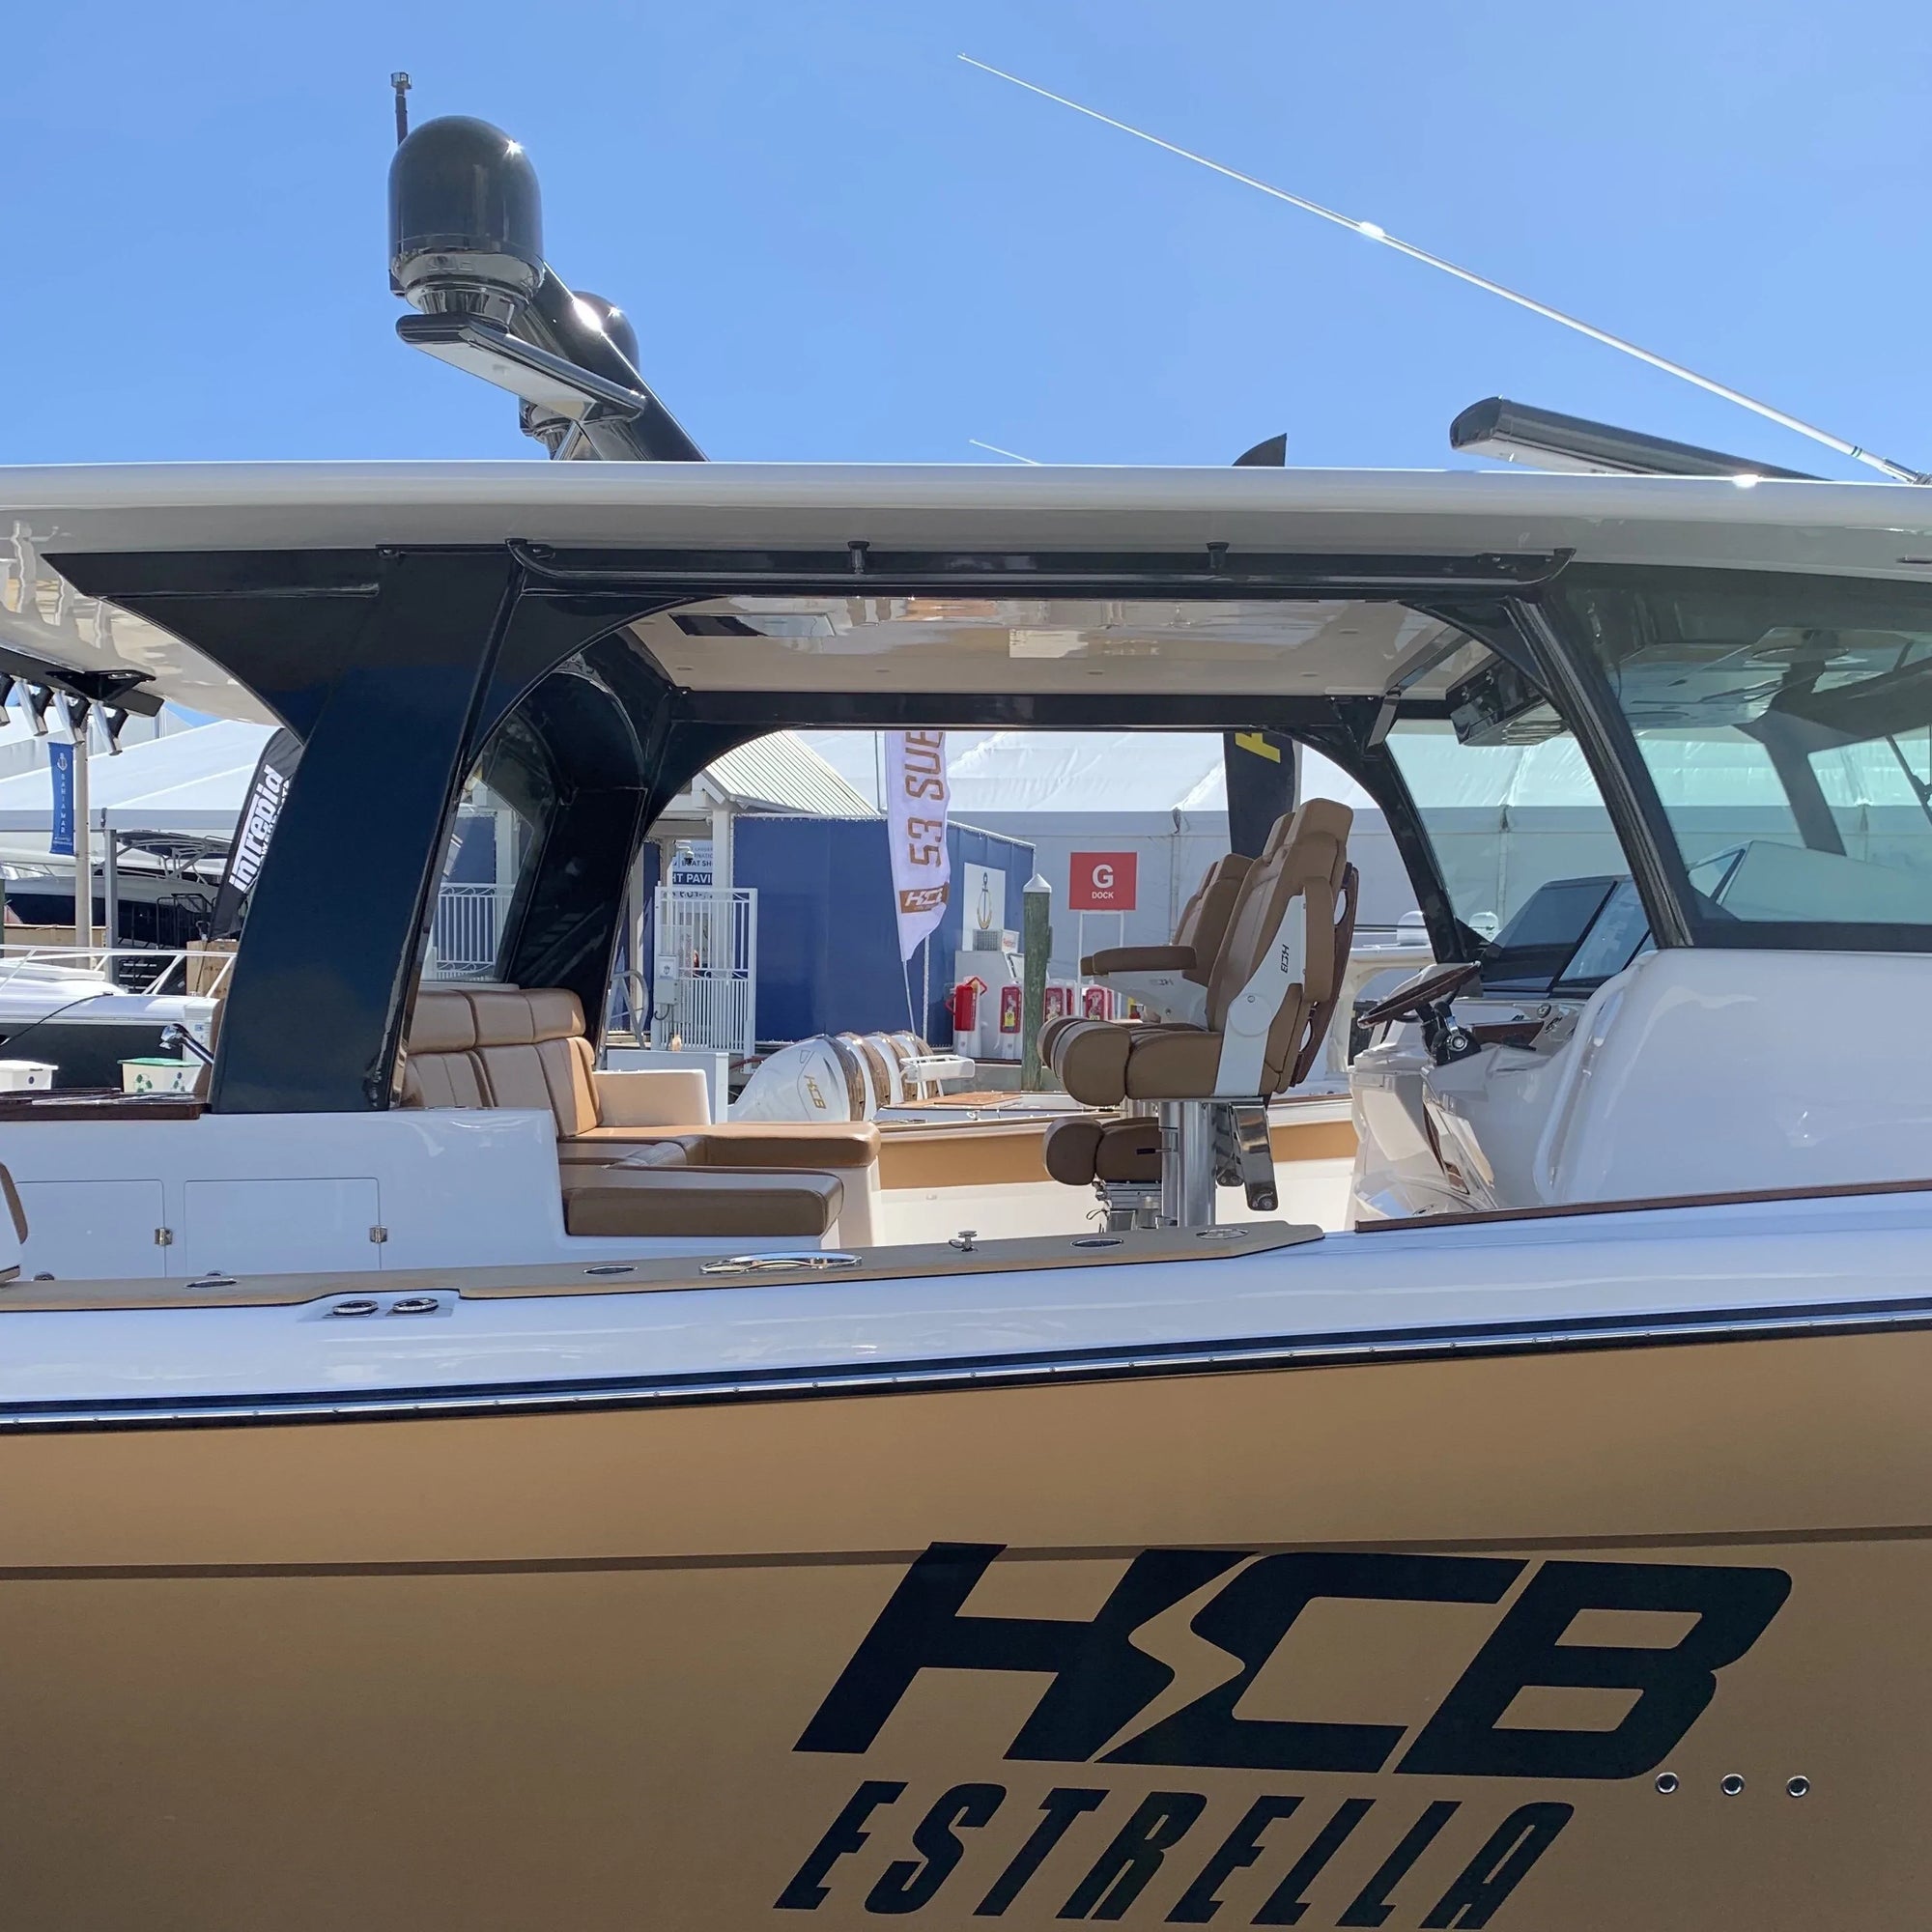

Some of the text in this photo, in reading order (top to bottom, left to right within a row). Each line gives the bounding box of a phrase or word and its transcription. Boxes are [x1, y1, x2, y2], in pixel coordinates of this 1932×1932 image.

[908, 817, 943, 867] 53
[1092, 864, 1114, 889] G
[1092, 891, 1114, 899] DOCK
[791, 1542, 1792, 1779] HCB
[772, 1780, 1575, 1928] ESTRELLA
